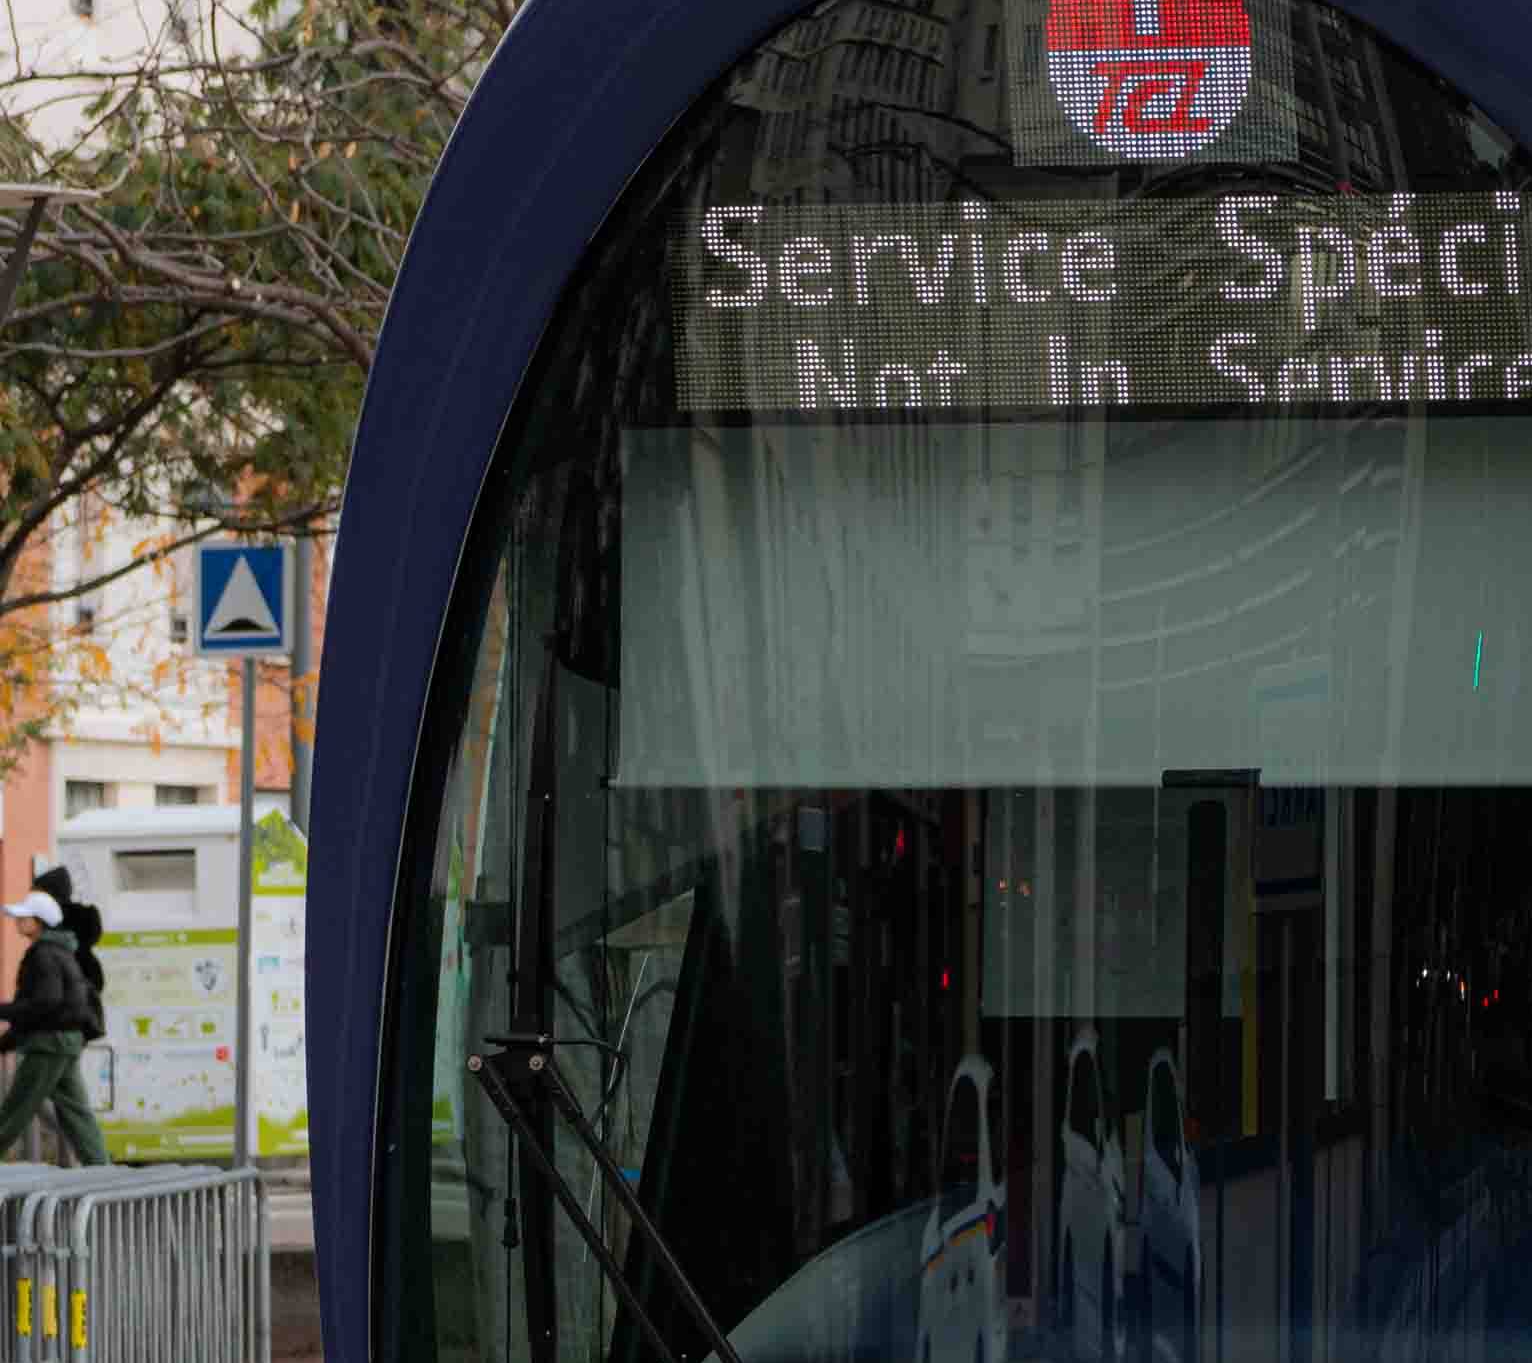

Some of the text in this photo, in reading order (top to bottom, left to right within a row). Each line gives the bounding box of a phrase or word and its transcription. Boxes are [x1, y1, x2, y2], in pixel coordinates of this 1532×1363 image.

[700, 200, 1118, 308] Service
[797, 338, 966, 408] Not
[1044, 334, 1130, 406] In
